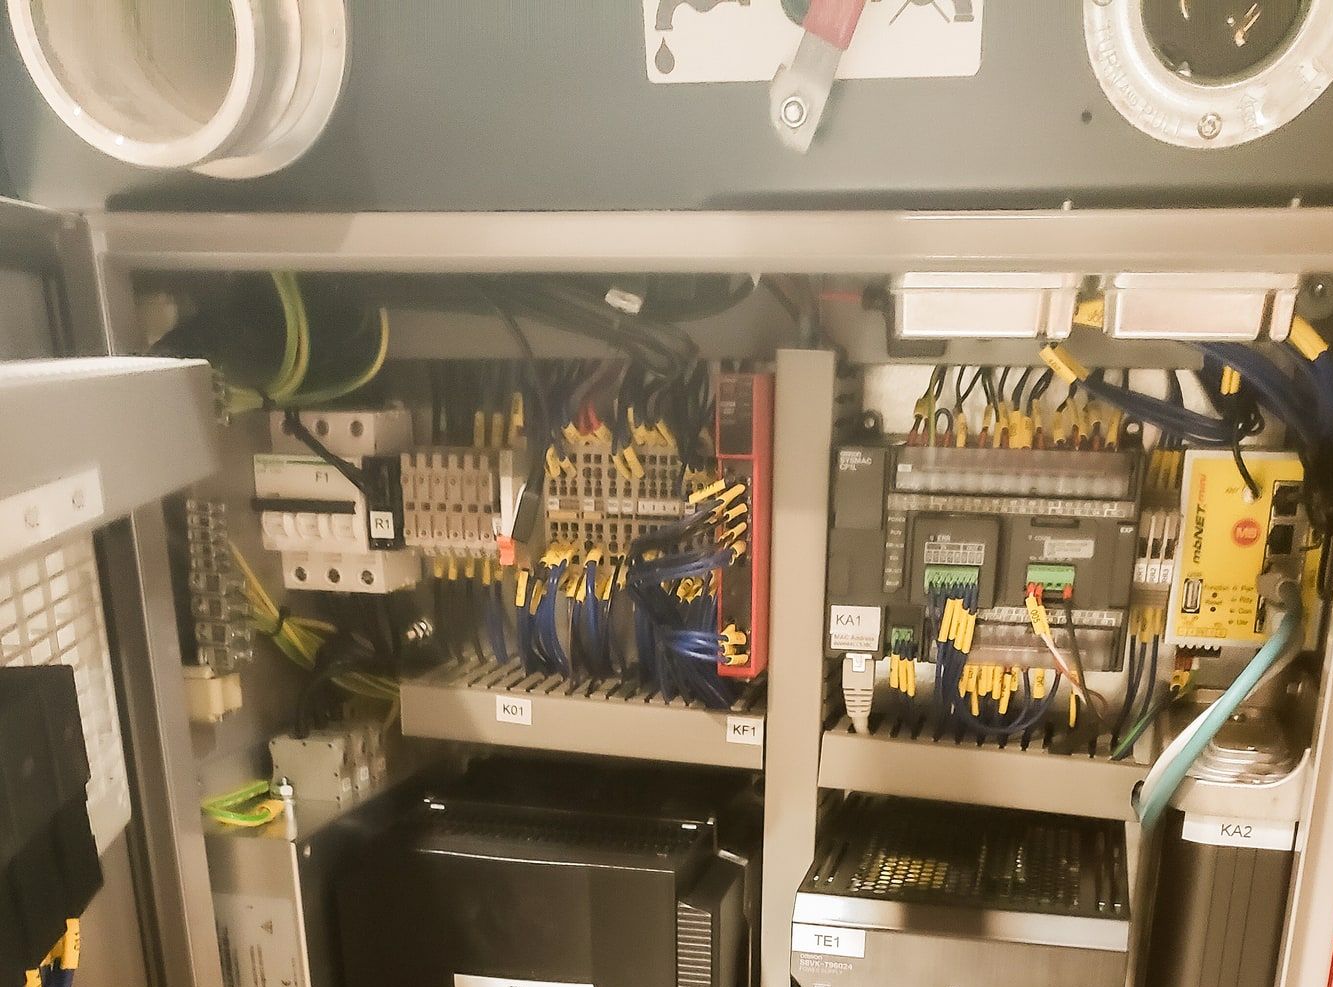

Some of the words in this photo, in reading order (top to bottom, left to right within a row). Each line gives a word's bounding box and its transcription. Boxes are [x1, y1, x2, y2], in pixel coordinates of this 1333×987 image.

[315, 472, 330, 483] F1
[375, 517, 390, 529] R1
[836, 614, 861, 627] KA1
[733, 724, 756, 737] KF1
[1220, 823, 1253, 839] KA2
[814, 933, 841, 949] TE1
